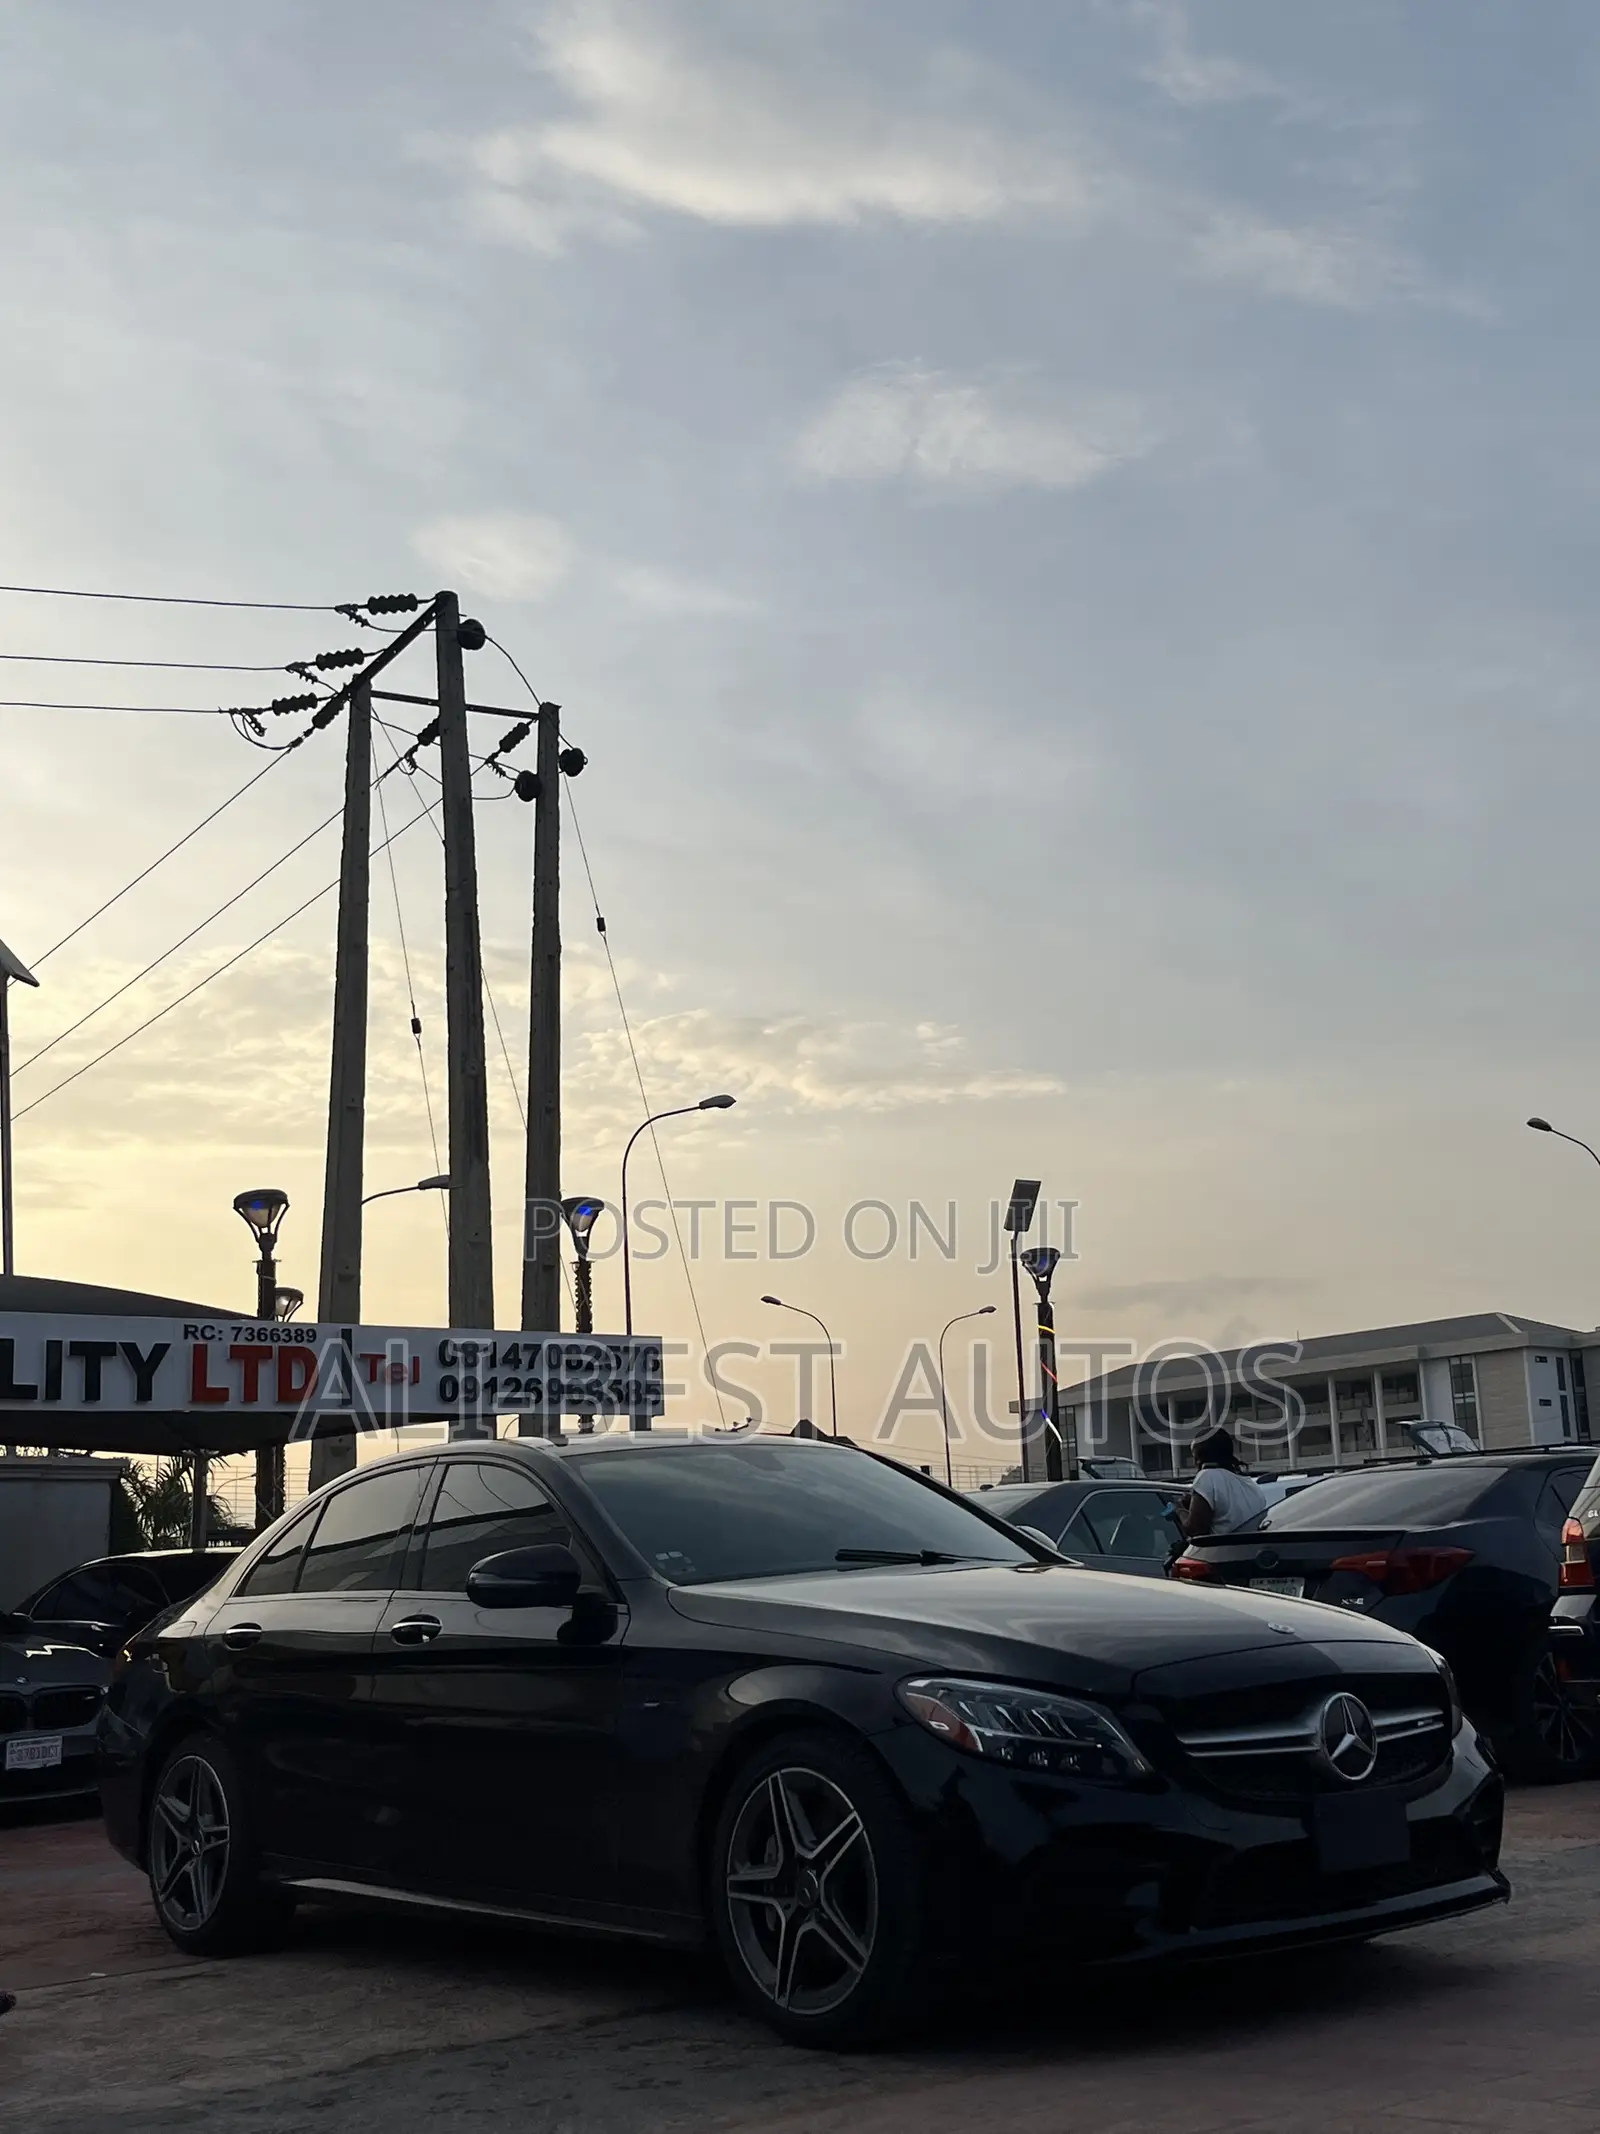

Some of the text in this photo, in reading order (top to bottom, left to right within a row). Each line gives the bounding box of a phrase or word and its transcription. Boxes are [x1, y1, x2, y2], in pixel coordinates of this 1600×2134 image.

[183, 1324, 318, 1344] RC: 7366389
[0, 1337, 319, 1405] LITY LTD
[359, 1353, 420, 1385] Tel
